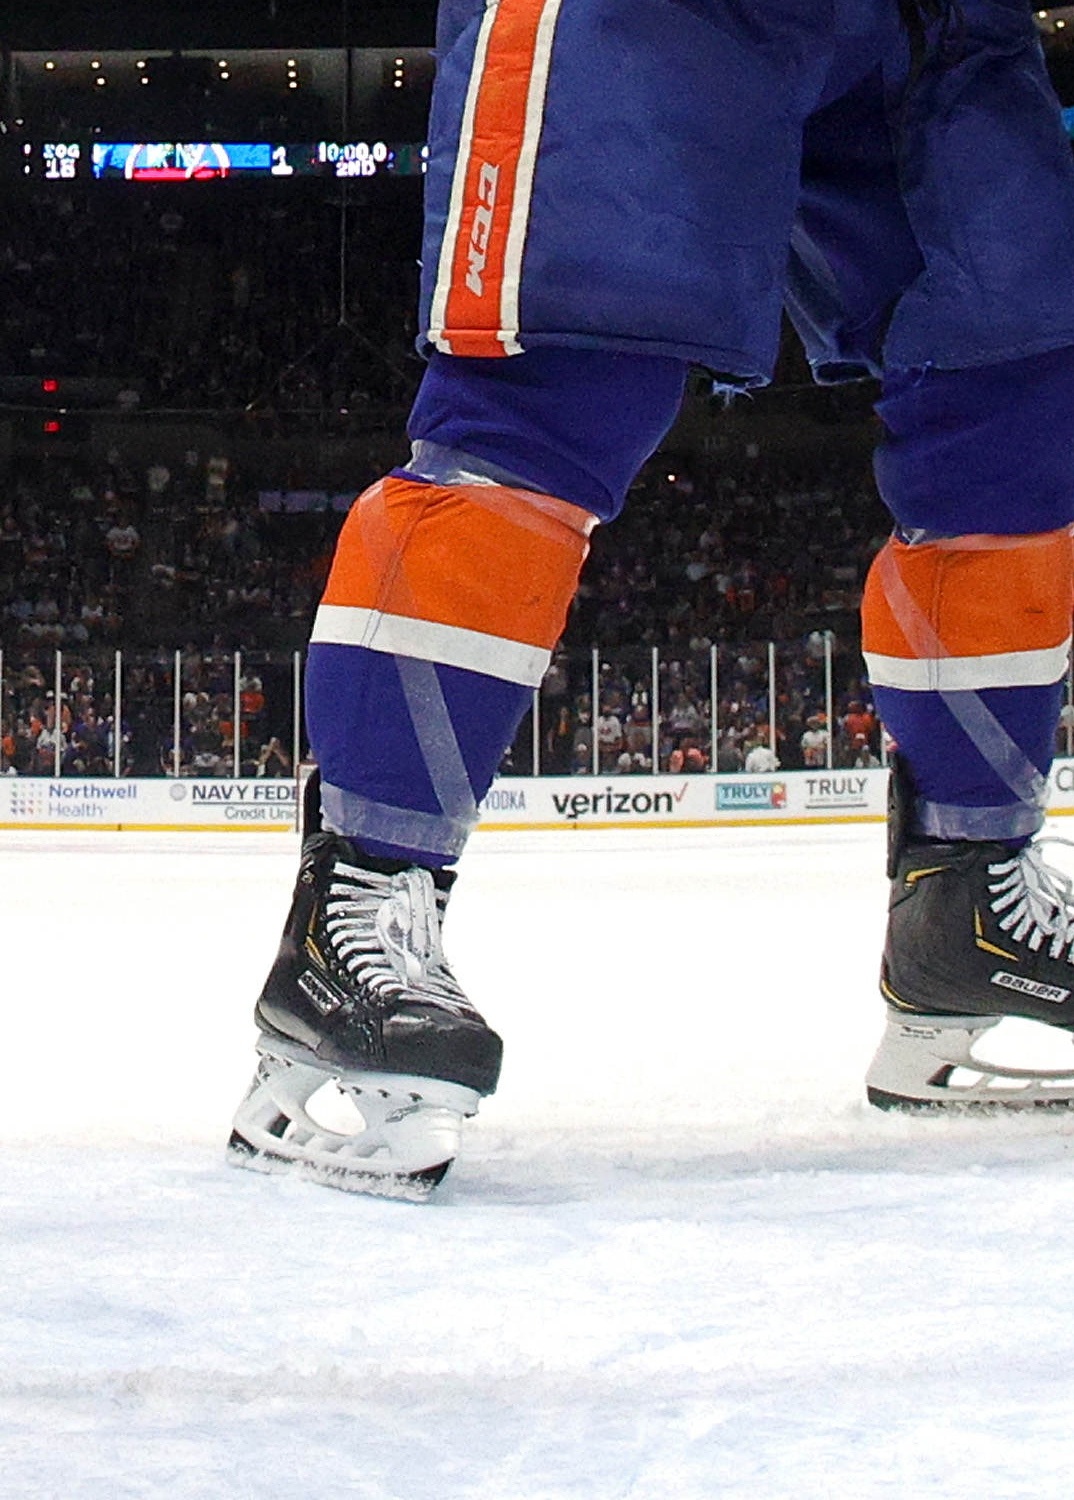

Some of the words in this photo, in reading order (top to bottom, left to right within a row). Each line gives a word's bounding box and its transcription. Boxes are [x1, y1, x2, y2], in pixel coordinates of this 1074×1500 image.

[43, 144, 80, 159] SOG
[271, 146, 293, 175] 1
[318, 142, 387, 162] 10:00.0
[335, 160, 377, 176] 2ND
[465, 161, 500, 297] CCM
[50, 783, 138, 799] Northwell
[192, 784, 247, 801] NAVY
[722, 785, 769, 799] TRULY
[805, 777, 868, 795] TRULY
[484, 790, 526, 811] VODKA
[552, 786, 673, 814] verizon
[50, 802, 102, 818] Health
[225, 806, 266, 820] Credit
[998, 974, 1062, 999] BAUER
